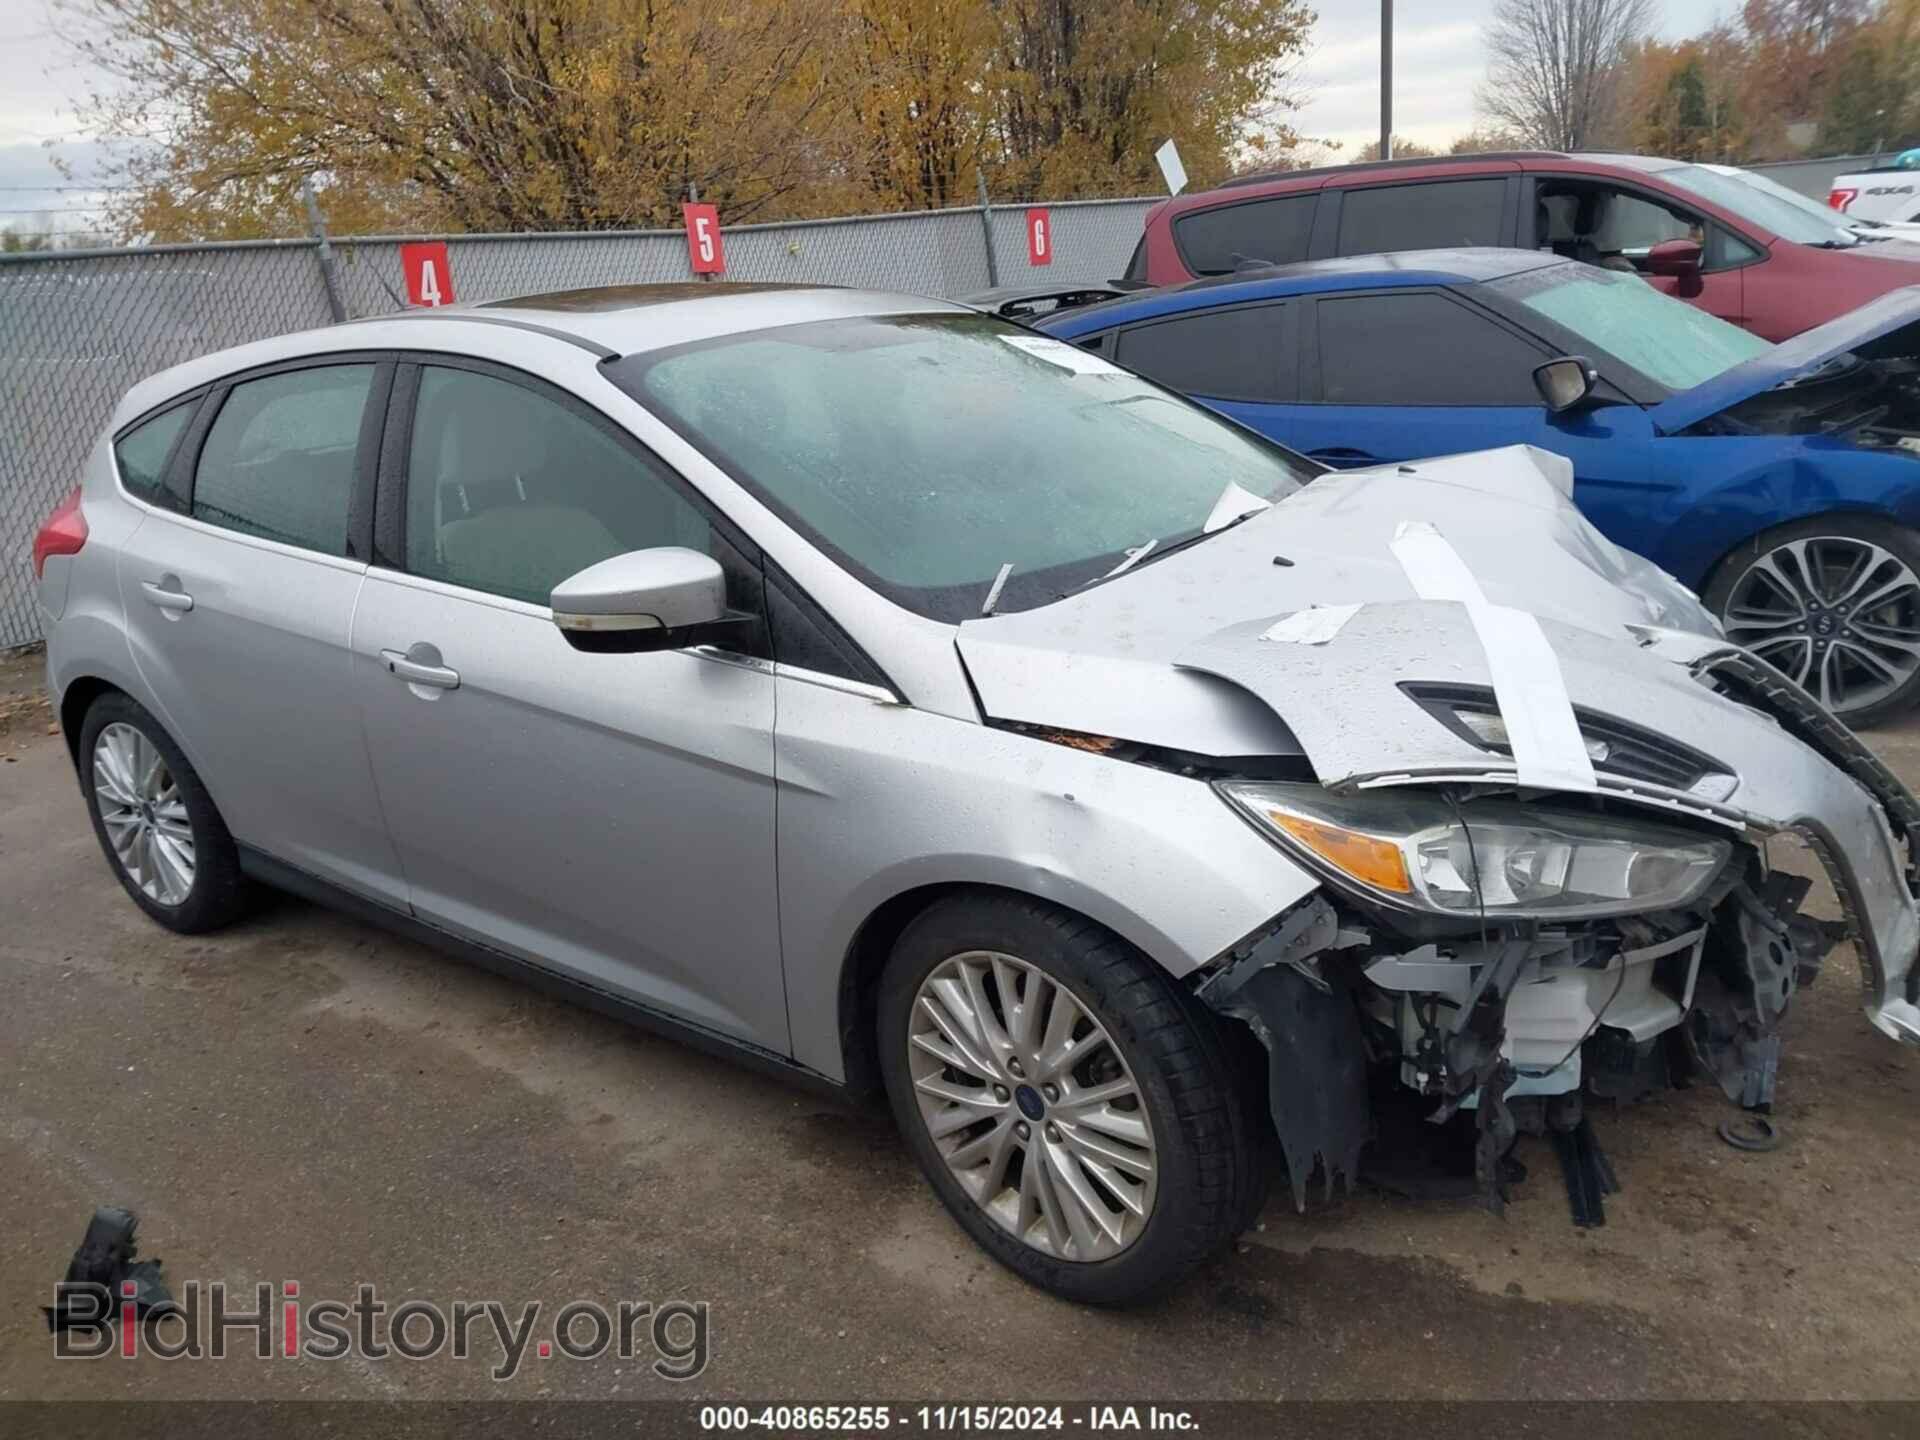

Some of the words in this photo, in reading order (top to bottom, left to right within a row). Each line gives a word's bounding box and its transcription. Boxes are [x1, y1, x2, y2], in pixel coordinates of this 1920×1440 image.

[696, 217, 714, 262] 5
[1034, 219, 1045, 256] 6
[421, 260, 442, 306] 4
